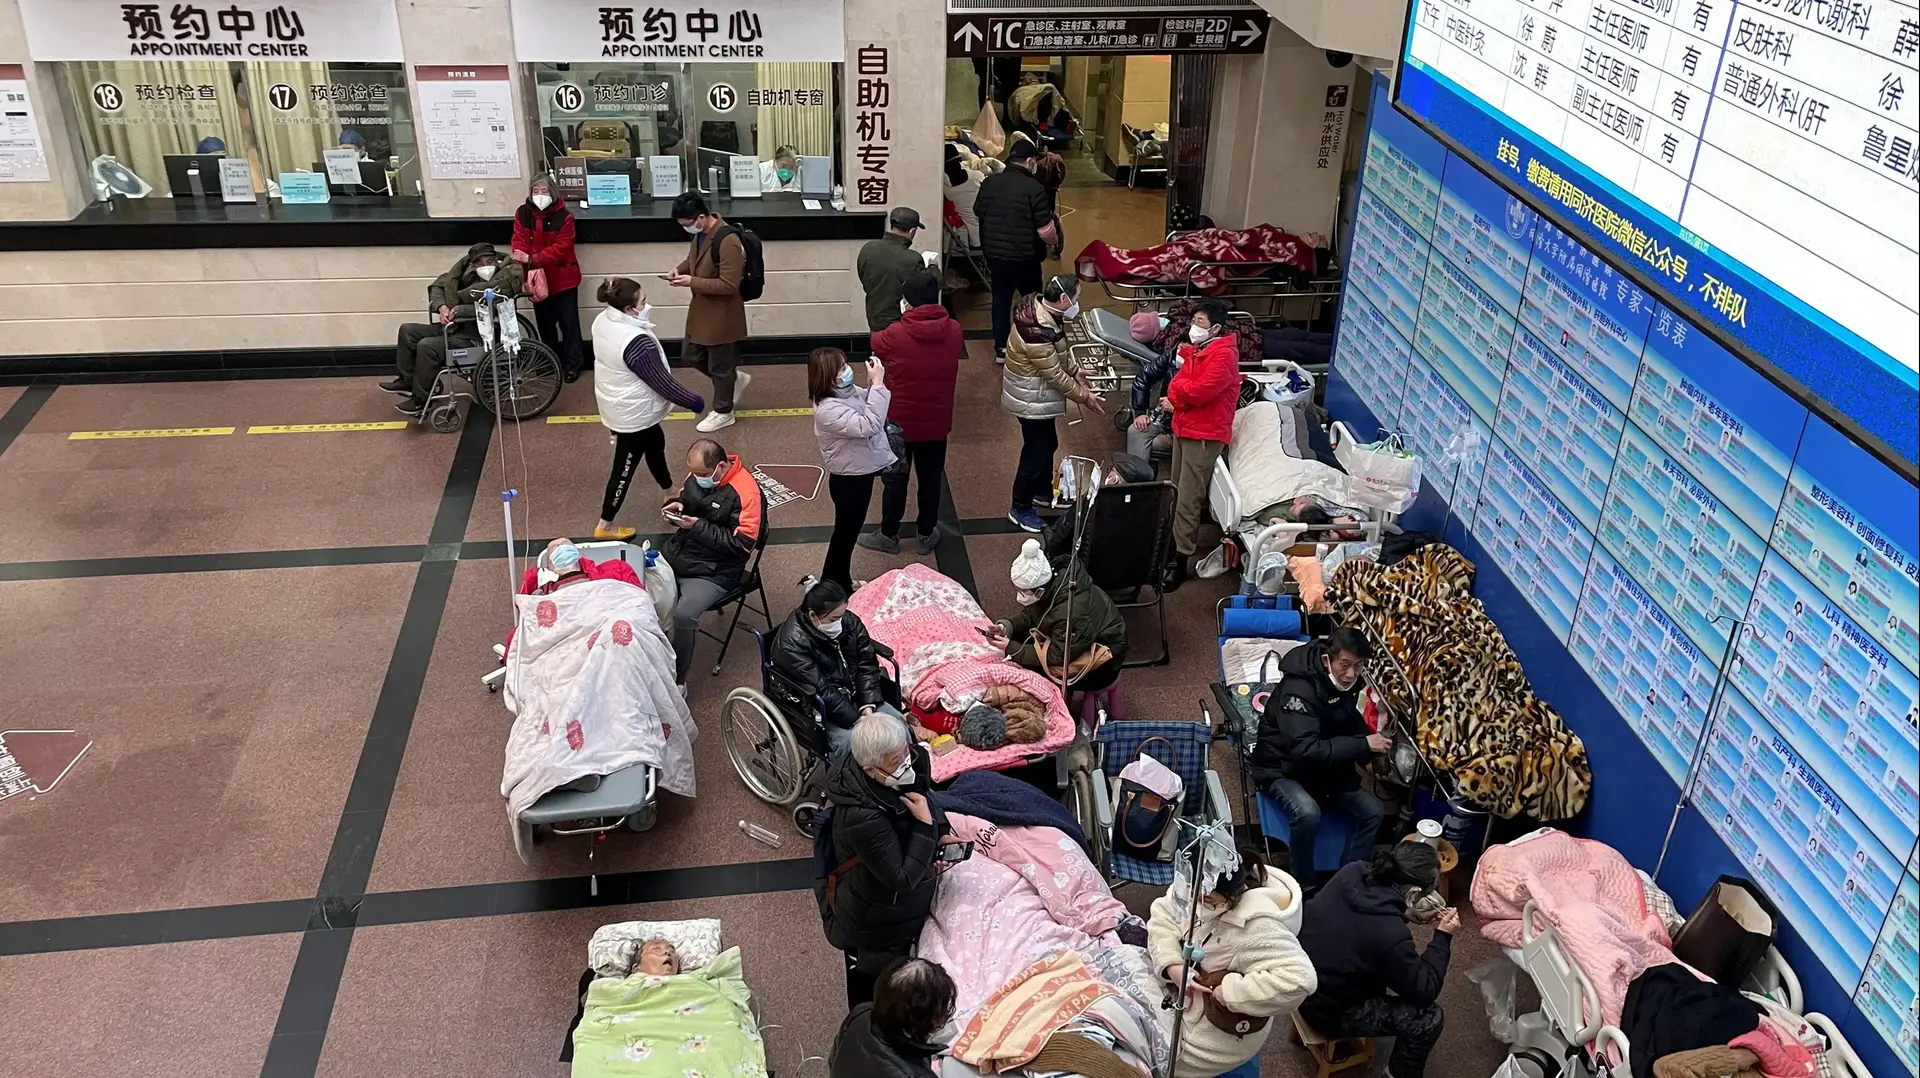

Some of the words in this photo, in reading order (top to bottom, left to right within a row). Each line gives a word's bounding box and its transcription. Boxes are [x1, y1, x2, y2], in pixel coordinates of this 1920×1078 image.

[121, 4, 305, 41] 预约中心
[598, 7, 762, 42] 预约中心
[1165, 20, 1194, 30] 检验科
[1205, 19, 1228, 32] 2D
[1693, 0, 1713, 32] 有
[993, 22, 1022, 48] 1C
[1195, 34, 1224, 44] 甘泉楼
[1589, 3, 1650, 53] 主任医师
[1682, 45, 1701, 77] 有
[130, 43, 242, 56] APPOINTMENT
[247, 43, 309, 56] CENTER
[601, 44, 704, 57] APPOINTMENT
[708, 44, 764, 57] CENTER
[1733, 17, 1794, 66] 皮肤科
[1878, 72, 1905, 111] 徐
[135, 84, 216, 100] 预约检查
[309, 84, 388, 101] 预约检查
[594, 85, 667, 101] 预约门诊
[1422, 1, 1440, 28] 下午
[1446, 14, 1485, 56] 中医针灸
[1572, 83, 1645, 146] 副主任医师
[1661, 133, 1679, 164] 有
[1580, 45, 1640, 96] 主任医师
[1671, 90, 1690, 121] 有
[96, 84, 119, 109] 18
[271, 85, 290, 109] 17
[558, 88, 576, 107] 16
[713, 87, 730, 106] 15
[747, 88, 824, 106] 自助机专窗
[1723, 62, 1830, 136] 普通外科(肝
[856, 44, 890, 205] 自助机专窗
[1317, 111, 1337, 169] 热水供应处
[1617, 279, 1688, 349] 专家一览表
[1810, 484, 1856, 529] 整形美容科
[1821, 603, 1841, 627] 儿科
[1841, 619, 1889, 671] 精神医学科
